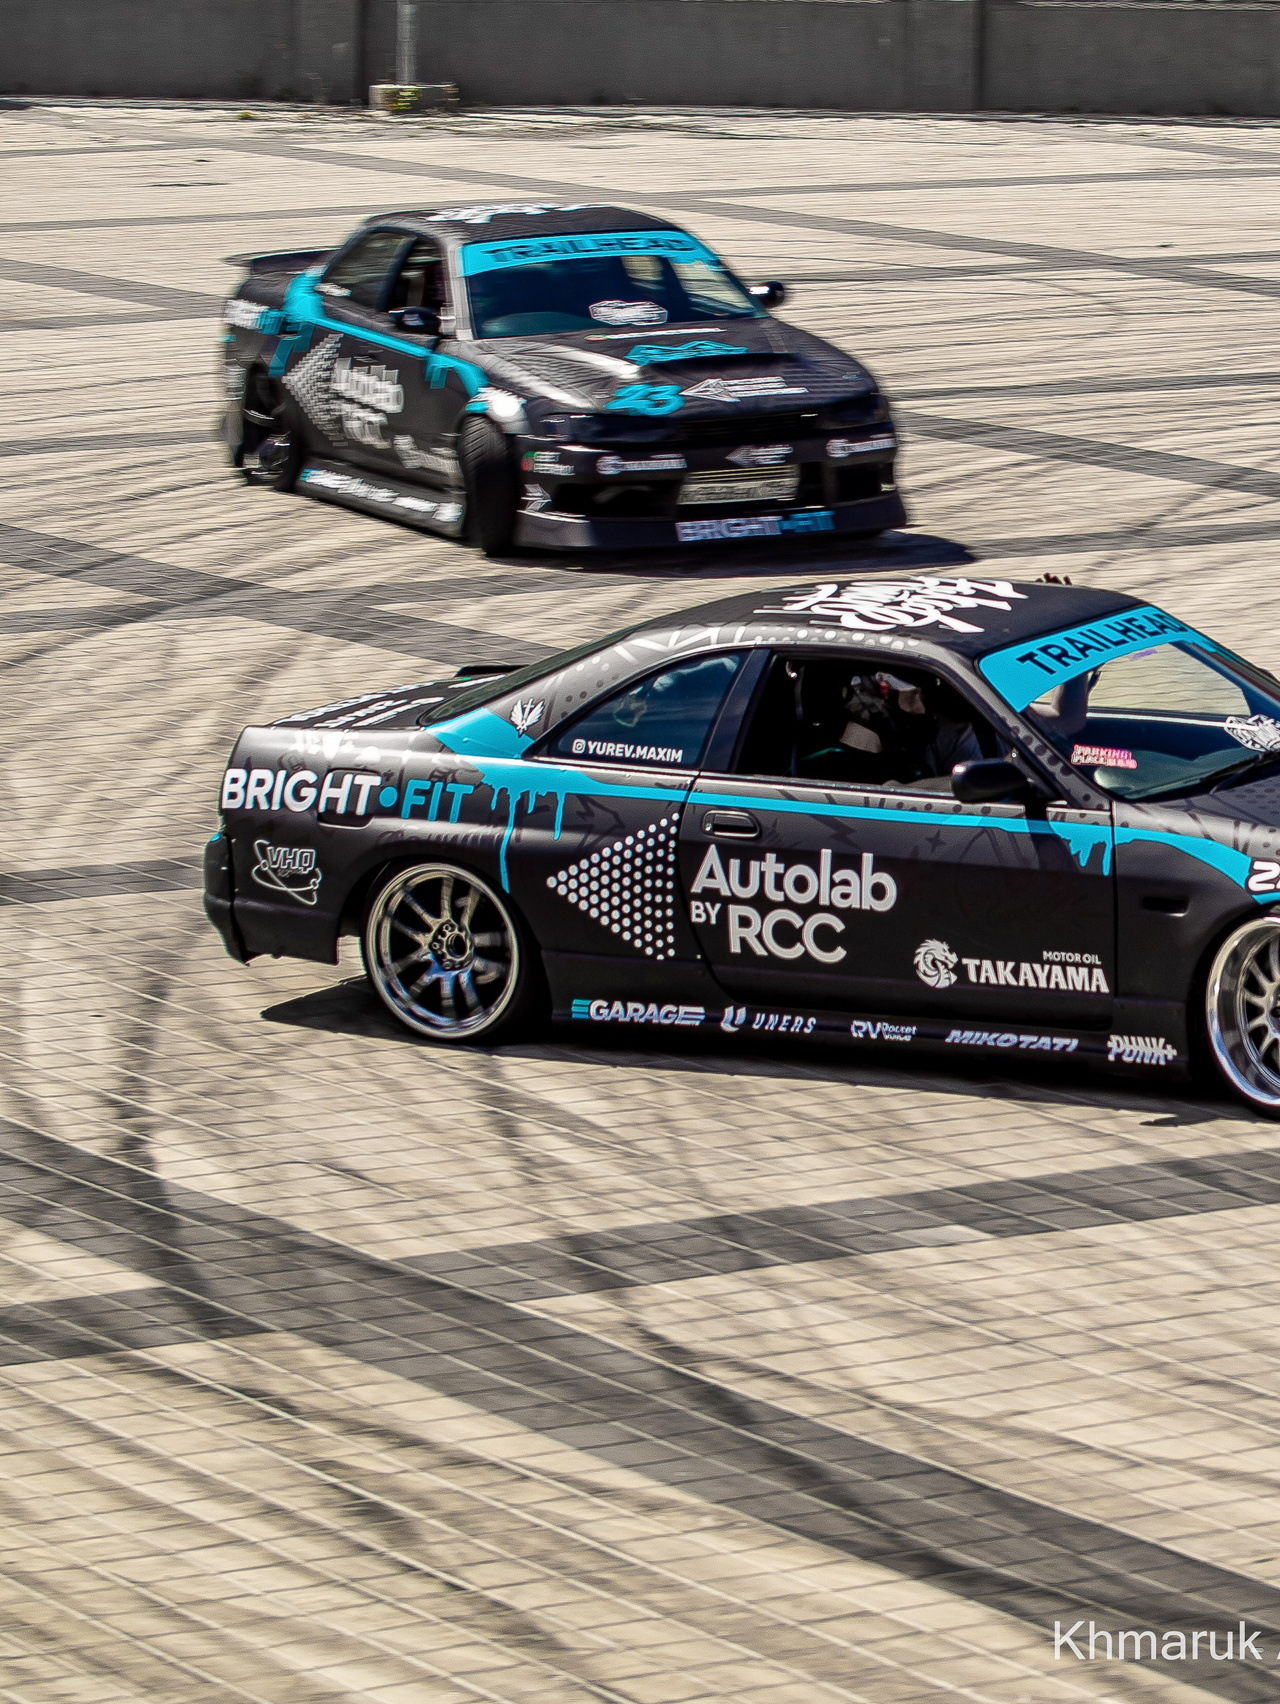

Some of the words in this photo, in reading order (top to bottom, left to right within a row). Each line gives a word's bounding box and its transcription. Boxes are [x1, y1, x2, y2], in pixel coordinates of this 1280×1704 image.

[691, 844, 897, 912] Autolab
[691, 901, 722, 925] BY
[728, 904, 847, 964] RCC
[1043, 950, 1081, 964] MOTOR
[1083, 952, 1102, 965] OIL
[962, 957, 1111, 994] TAKAYAMA
[589, 999, 706, 1026] GARAGE
[945, 1029, 1079, 1052] MIKOTATI
